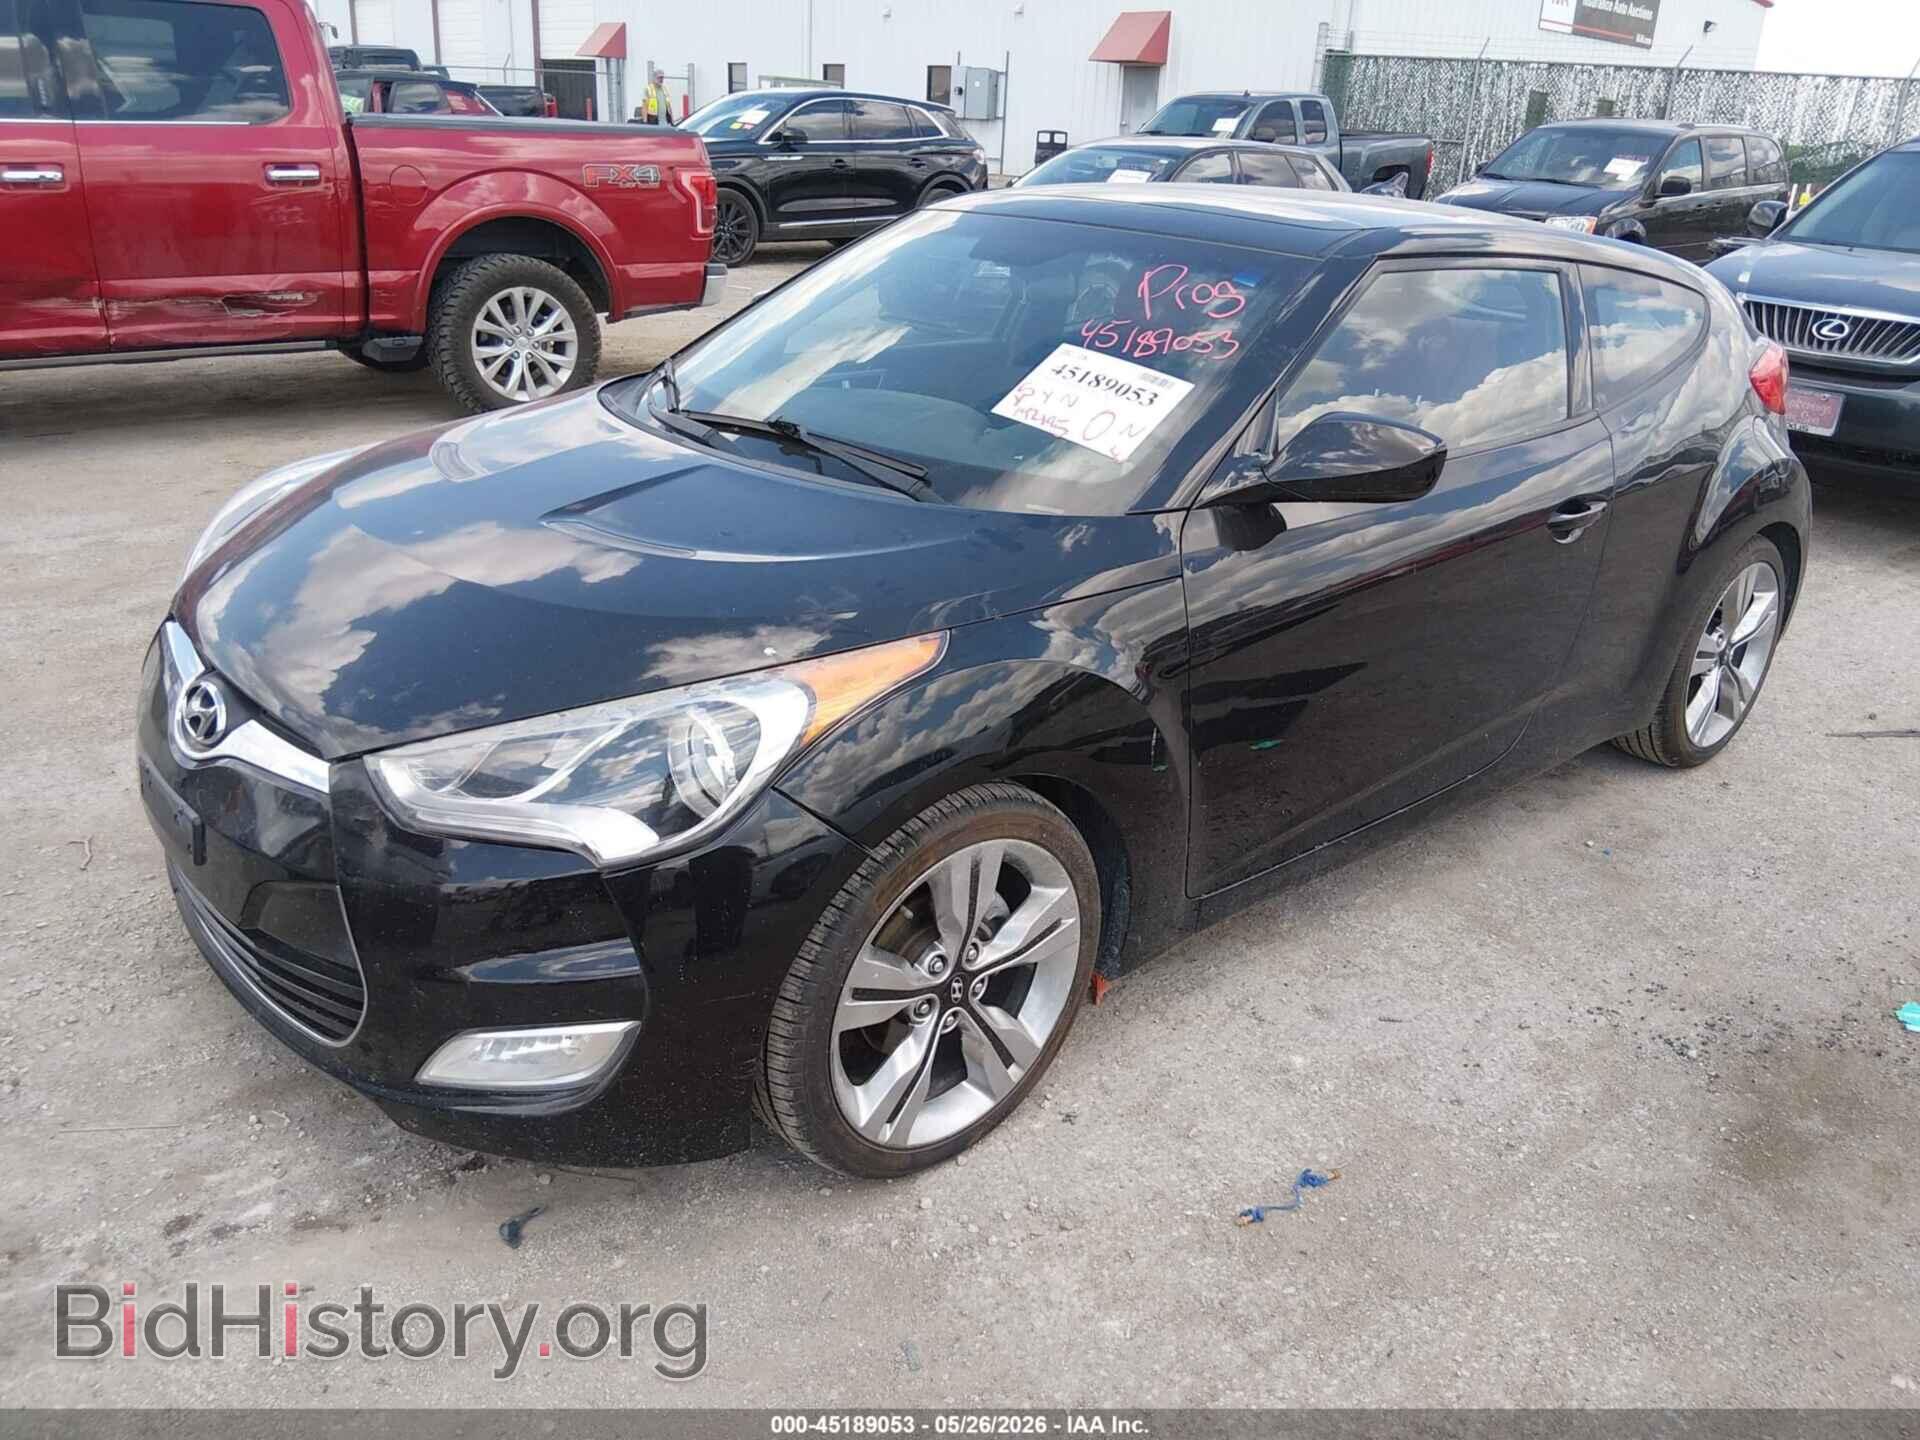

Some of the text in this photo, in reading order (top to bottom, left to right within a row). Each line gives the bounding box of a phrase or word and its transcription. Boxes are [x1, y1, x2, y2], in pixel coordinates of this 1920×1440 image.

[583, 164, 661, 187] FX4
[1080, 318, 1240, 360] 45189053
[1051, 363, 1160, 407] 45189053
